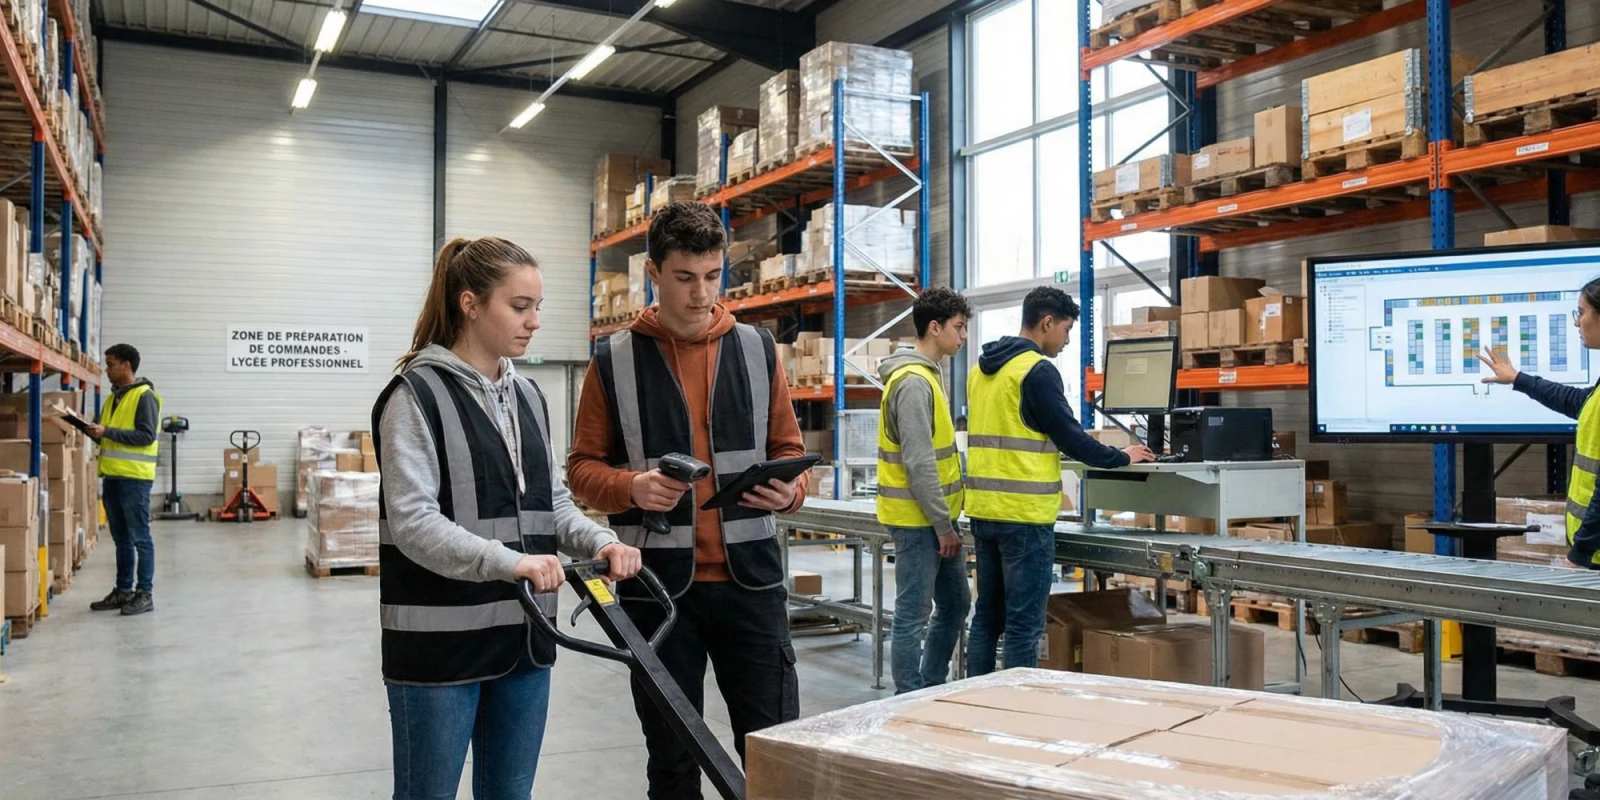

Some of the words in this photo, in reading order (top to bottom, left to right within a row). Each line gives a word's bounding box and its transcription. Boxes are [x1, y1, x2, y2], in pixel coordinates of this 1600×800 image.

[231, 331, 263, 341] ZONE
[267, 331, 282, 341] DE
[286, 330, 363, 342] PRÉPARATION
[249, 344, 264, 354] DE
[268, 344, 340, 355] COMMANDES
[231, 356, 267, 367] LYCÉE
[271, 357, 363, 368] PROFESSIONNEL
